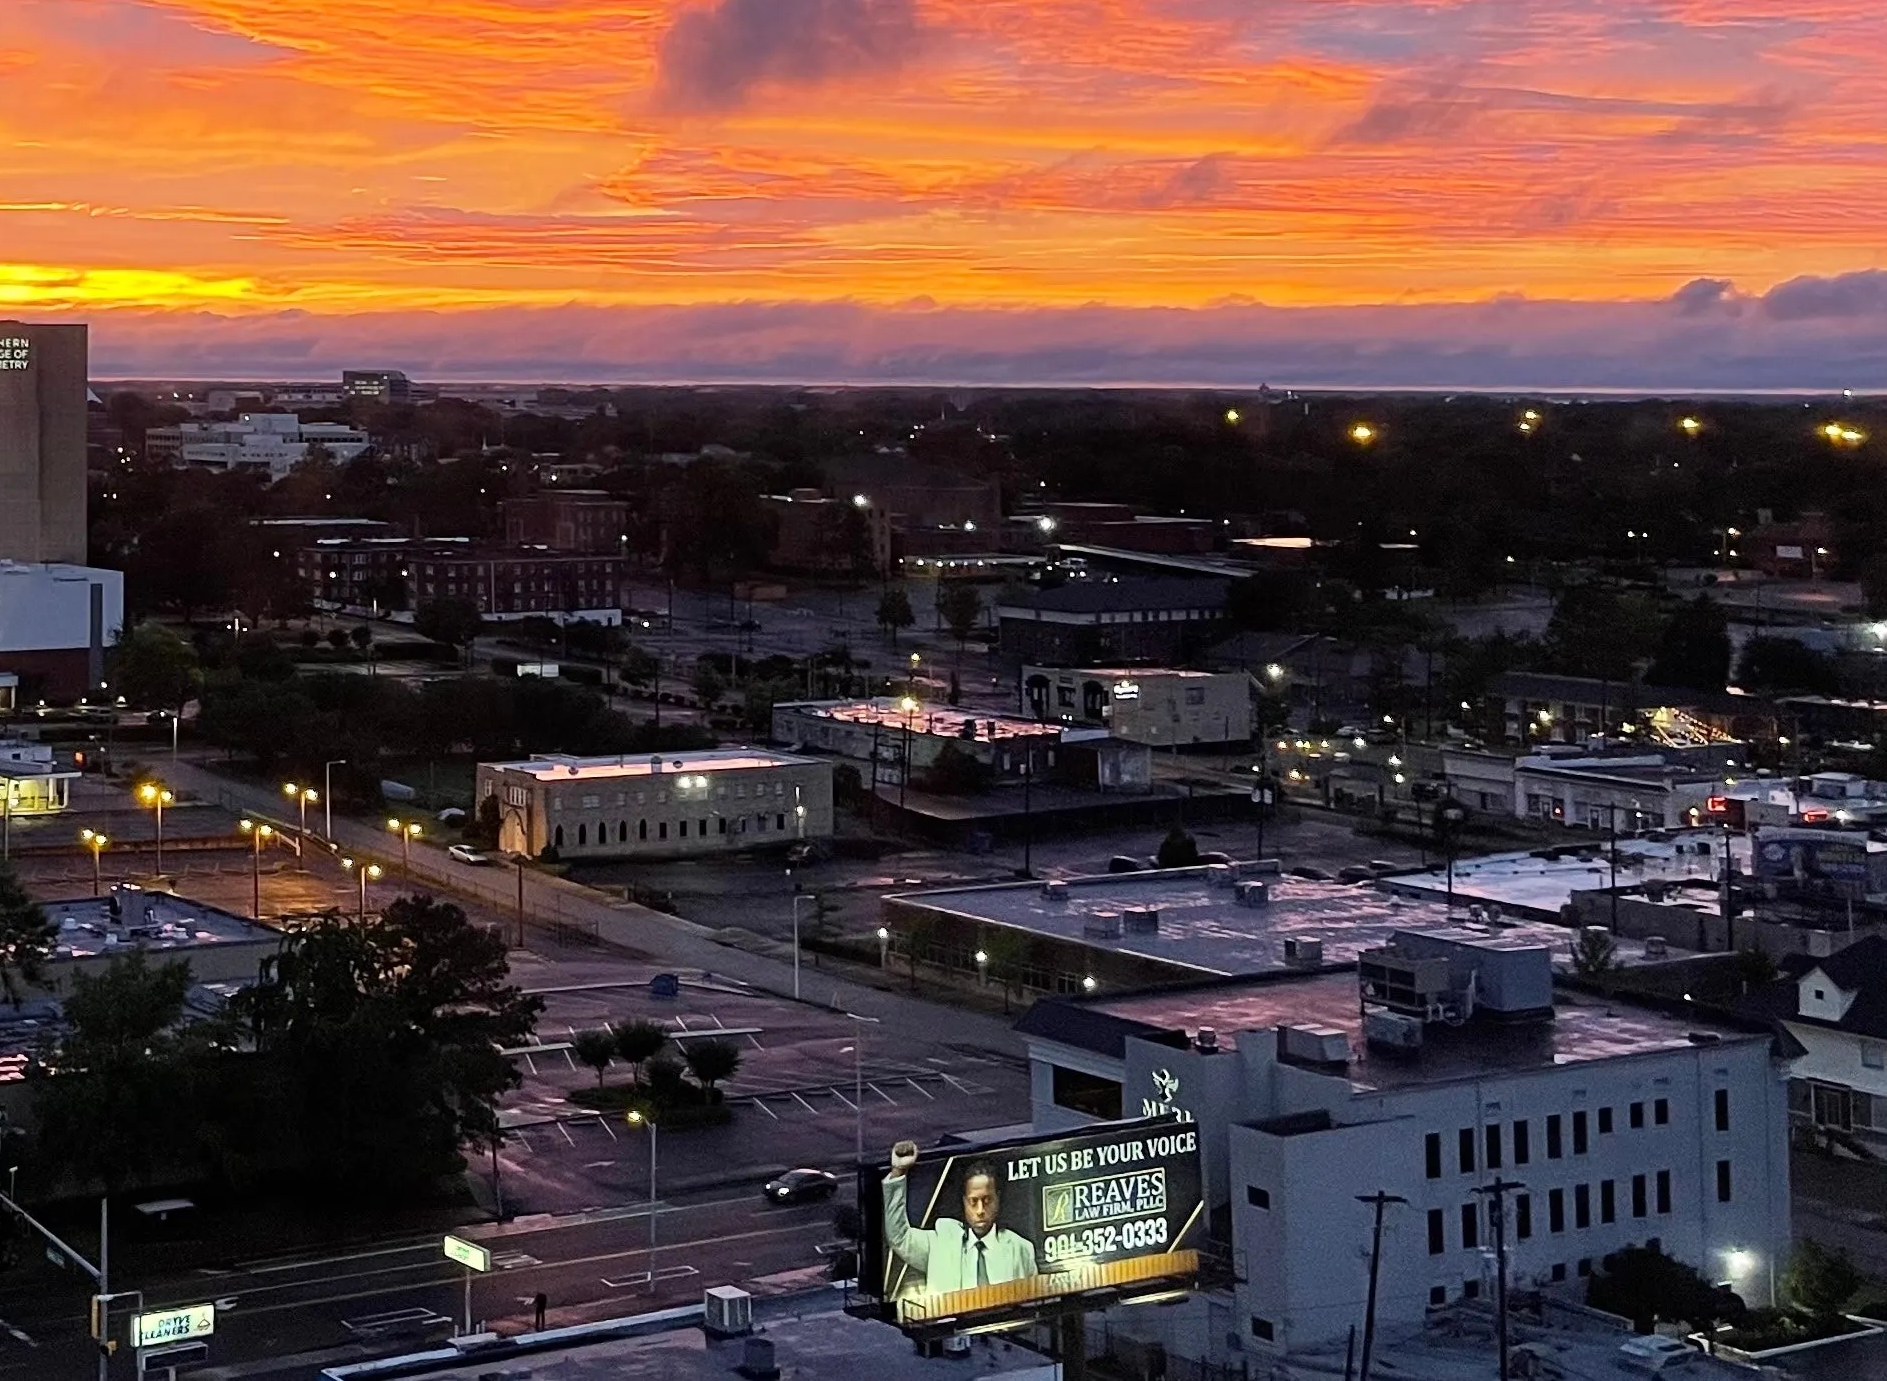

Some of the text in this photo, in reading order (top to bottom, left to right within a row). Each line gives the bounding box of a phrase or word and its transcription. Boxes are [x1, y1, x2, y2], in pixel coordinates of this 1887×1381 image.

[13, 349, 28, 359] OF
[1007, 1132, 1197, 1181] LET US BE YOUR VOICE
[1074, 1173, 1164, 1208] REAVES
[1075, 1206, 1100, 1221] LAW
[1136, 1195, 1163, 1211] PLLC
[1044, 1217, 1168, 1263] 901-352-0333
[140, 1325, 190, 1340] LEANERS
